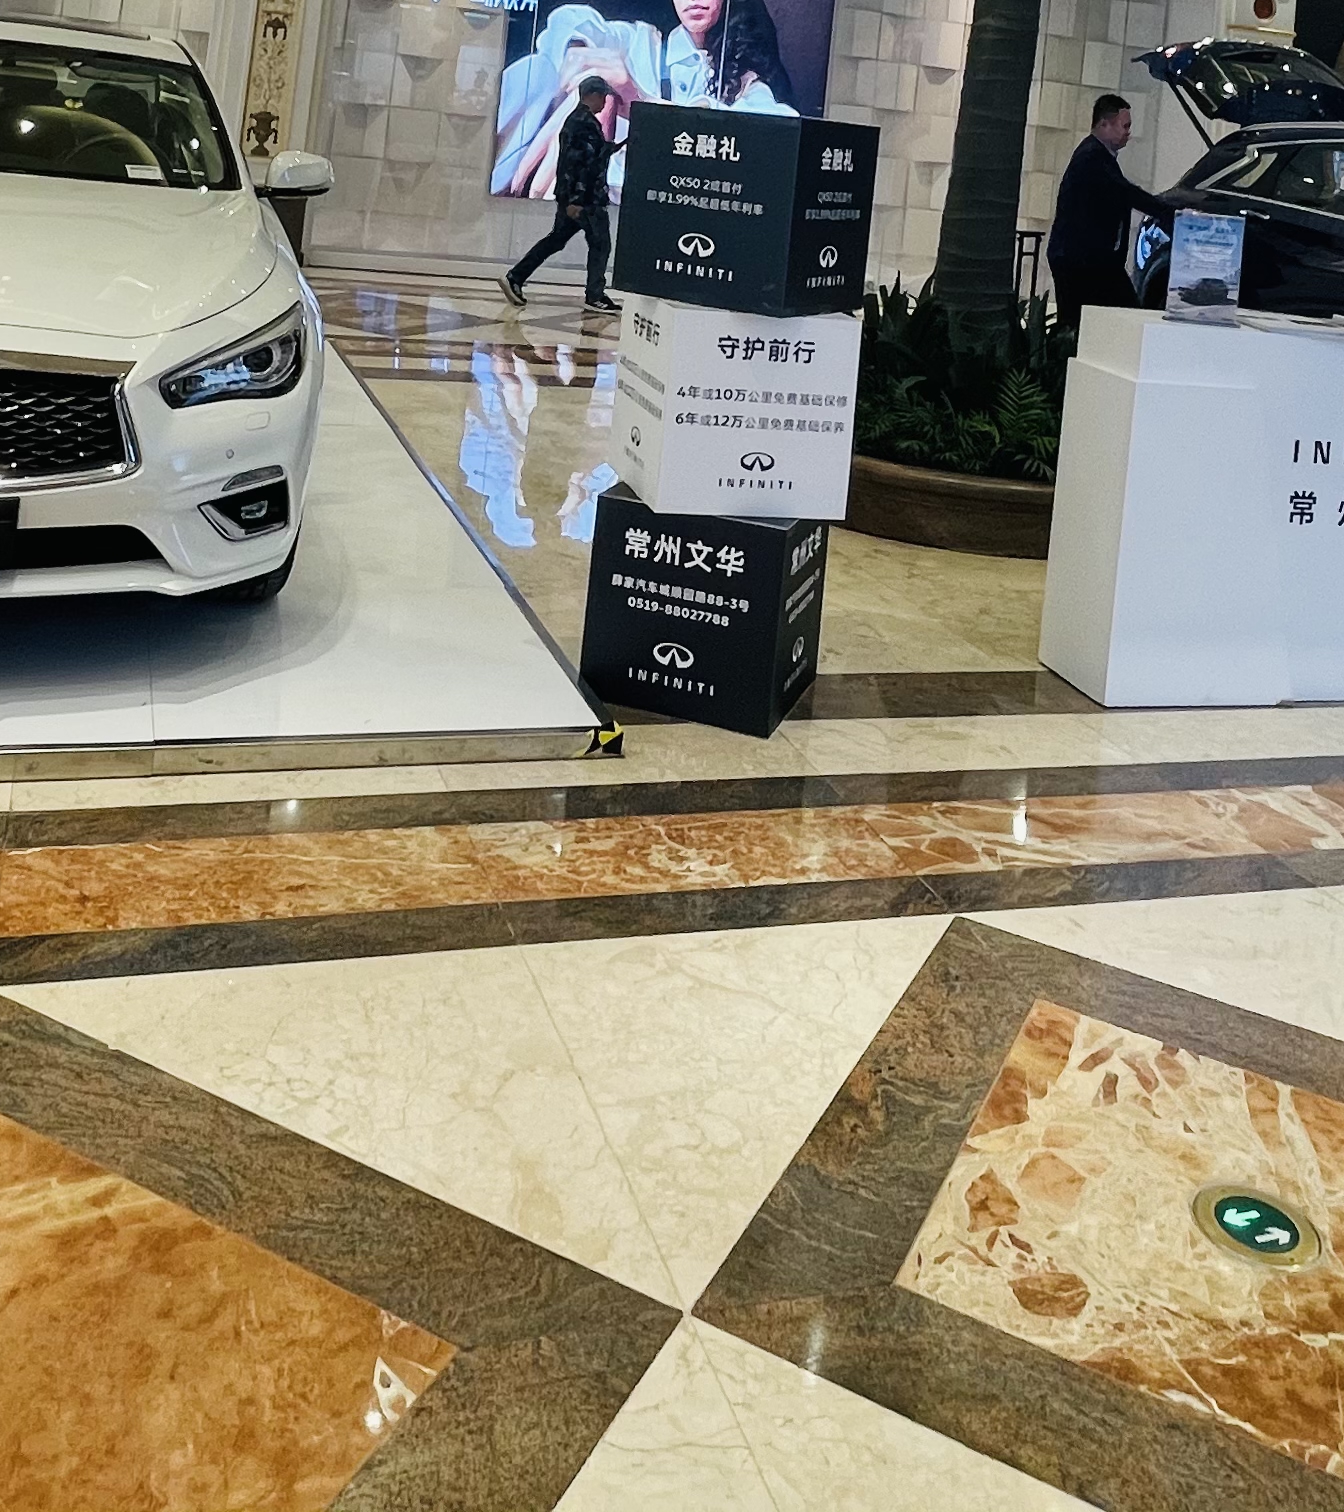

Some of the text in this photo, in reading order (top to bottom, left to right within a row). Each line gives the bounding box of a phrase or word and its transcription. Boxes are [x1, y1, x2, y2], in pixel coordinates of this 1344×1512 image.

[672, 131, 741, 162] 金融礼
[820, 146, 854, 172] 金融礼
[669, 175, 701, 190] QX50
[655, 258, 734, 283] INFINITI
[717, 334, 816, 364] 守护前行
[718, 477, 793, 491] INFINITI
[624, 527, 745, 577] 常州文华
[627, 667, 716, 698] INFINITI
